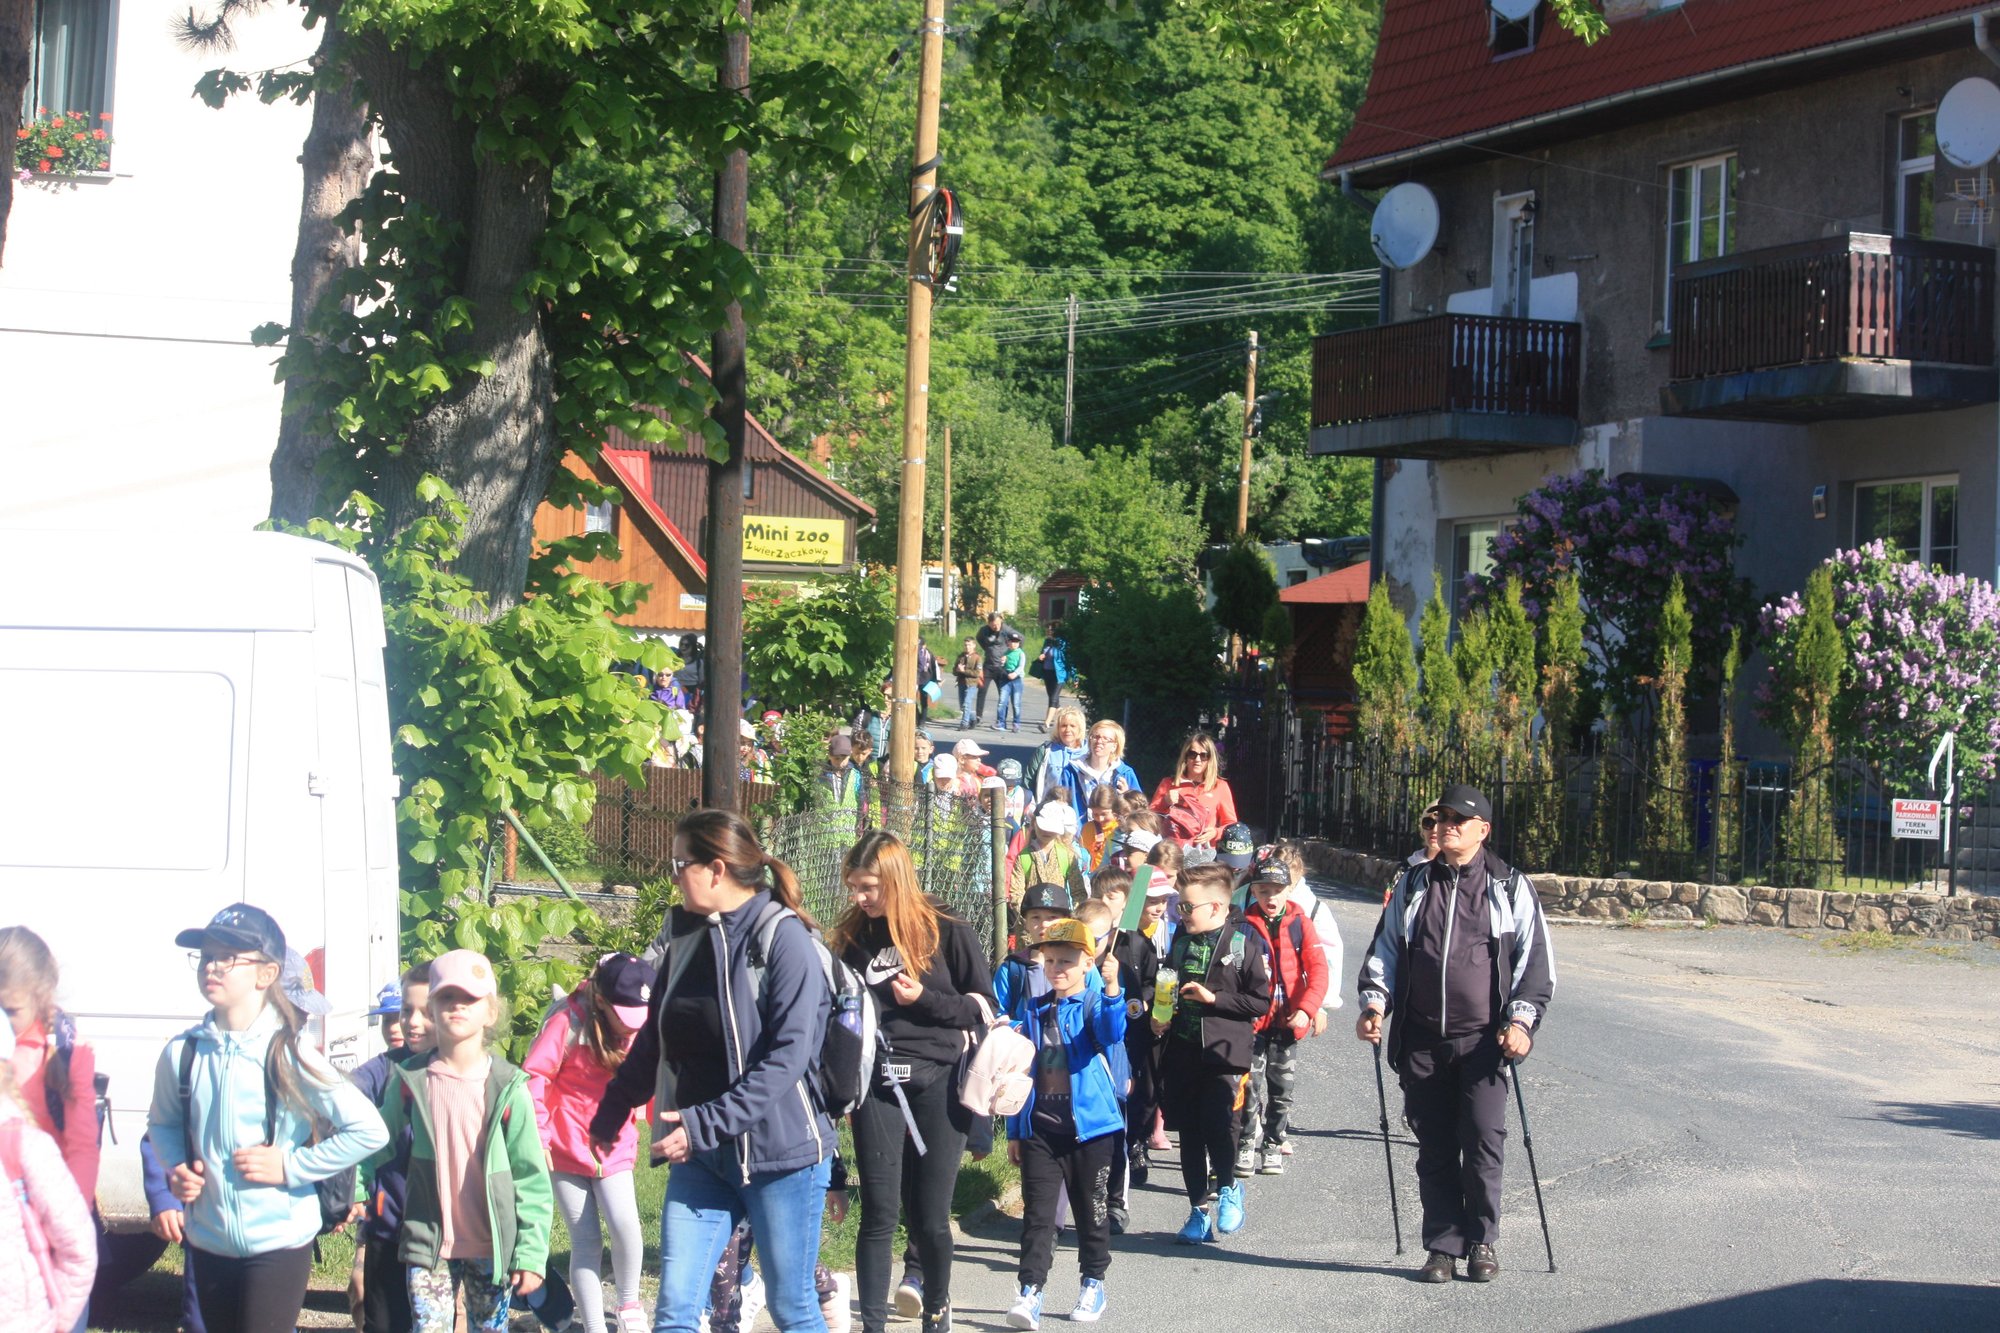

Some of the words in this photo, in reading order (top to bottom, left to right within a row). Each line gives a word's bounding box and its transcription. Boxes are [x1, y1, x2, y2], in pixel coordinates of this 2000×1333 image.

[745, 523, 789, 541] Mini
[795, 530, 830, 543] zoo
[1901, 802, 1931, 811] ZAKAZ
[882, 1065, 909, 1076] PMA
